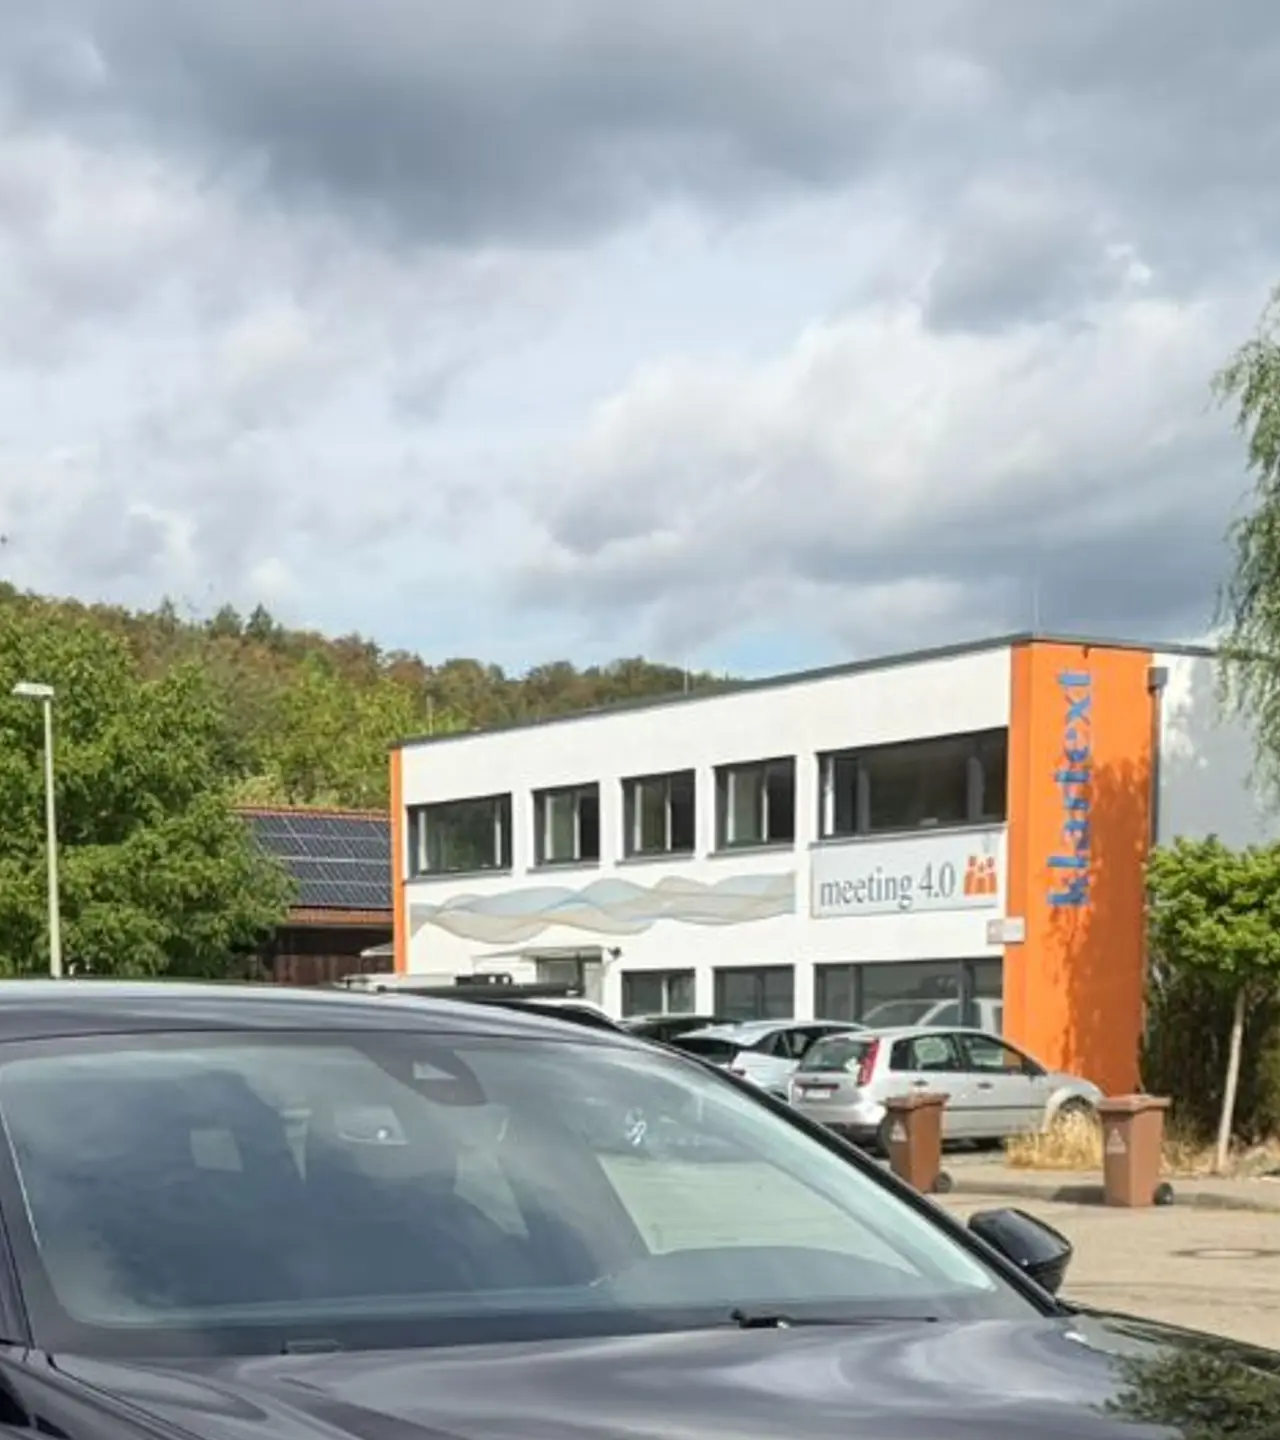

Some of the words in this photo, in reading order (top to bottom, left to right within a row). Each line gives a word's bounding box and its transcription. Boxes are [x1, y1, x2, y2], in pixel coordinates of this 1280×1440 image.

[1046, 672, 1091, 906] klartext
[820, 866, 914, 910] meeting
[919, 862, 957, 899] 4.0
